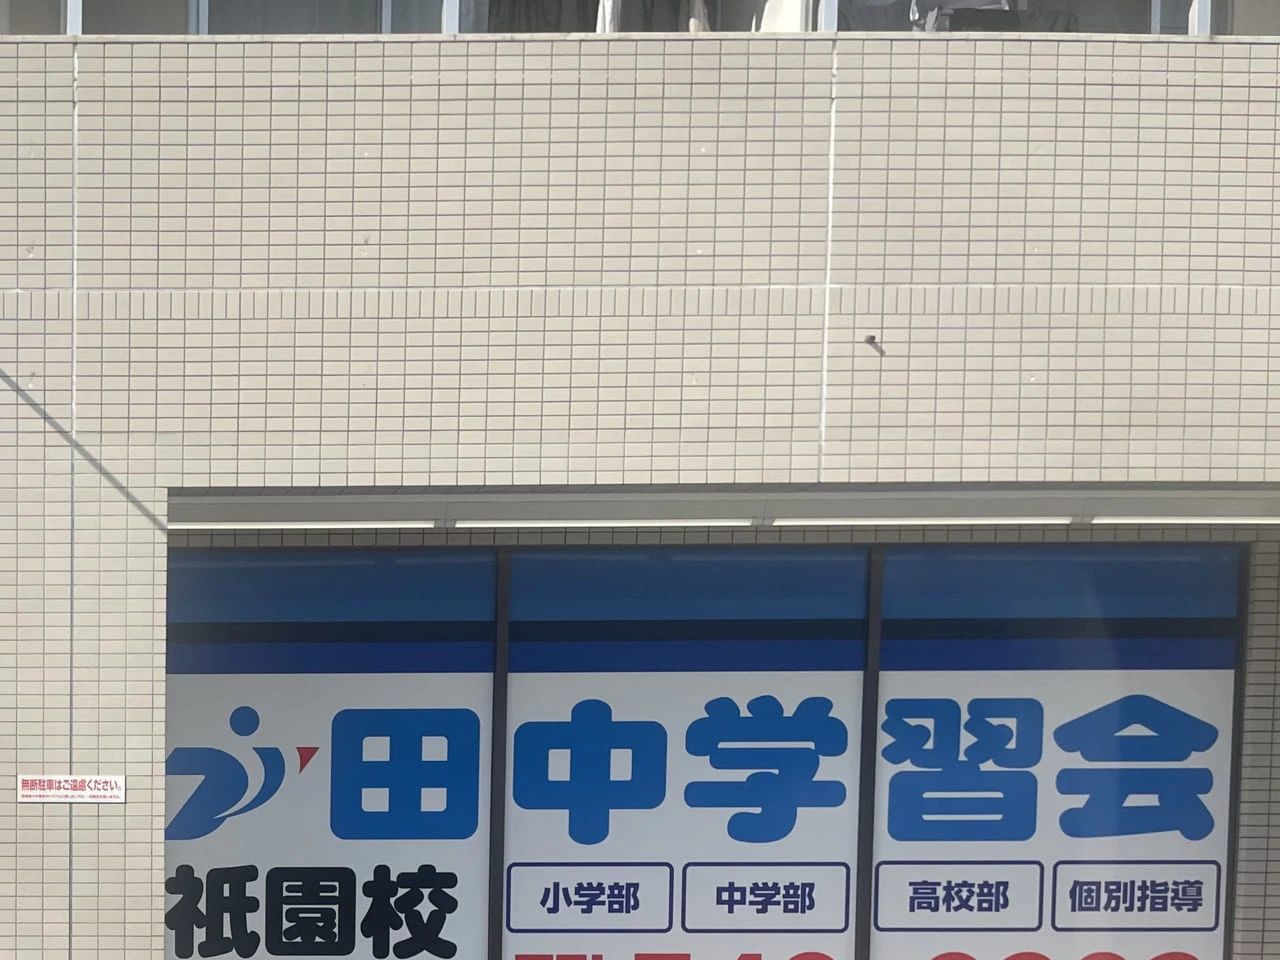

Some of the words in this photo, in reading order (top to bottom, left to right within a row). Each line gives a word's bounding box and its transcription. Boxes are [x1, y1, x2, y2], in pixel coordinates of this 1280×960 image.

[329, 694, 1220, 846] 田中学習会
[165, 864, 459, 960] 祇園校
[539, 881, 640, 915] 小学部
[715, 881, 816, 915] 中学部
[908, 880, 1010, 914] 高校部
[1068, 880, 1205, 914] 個別指導
